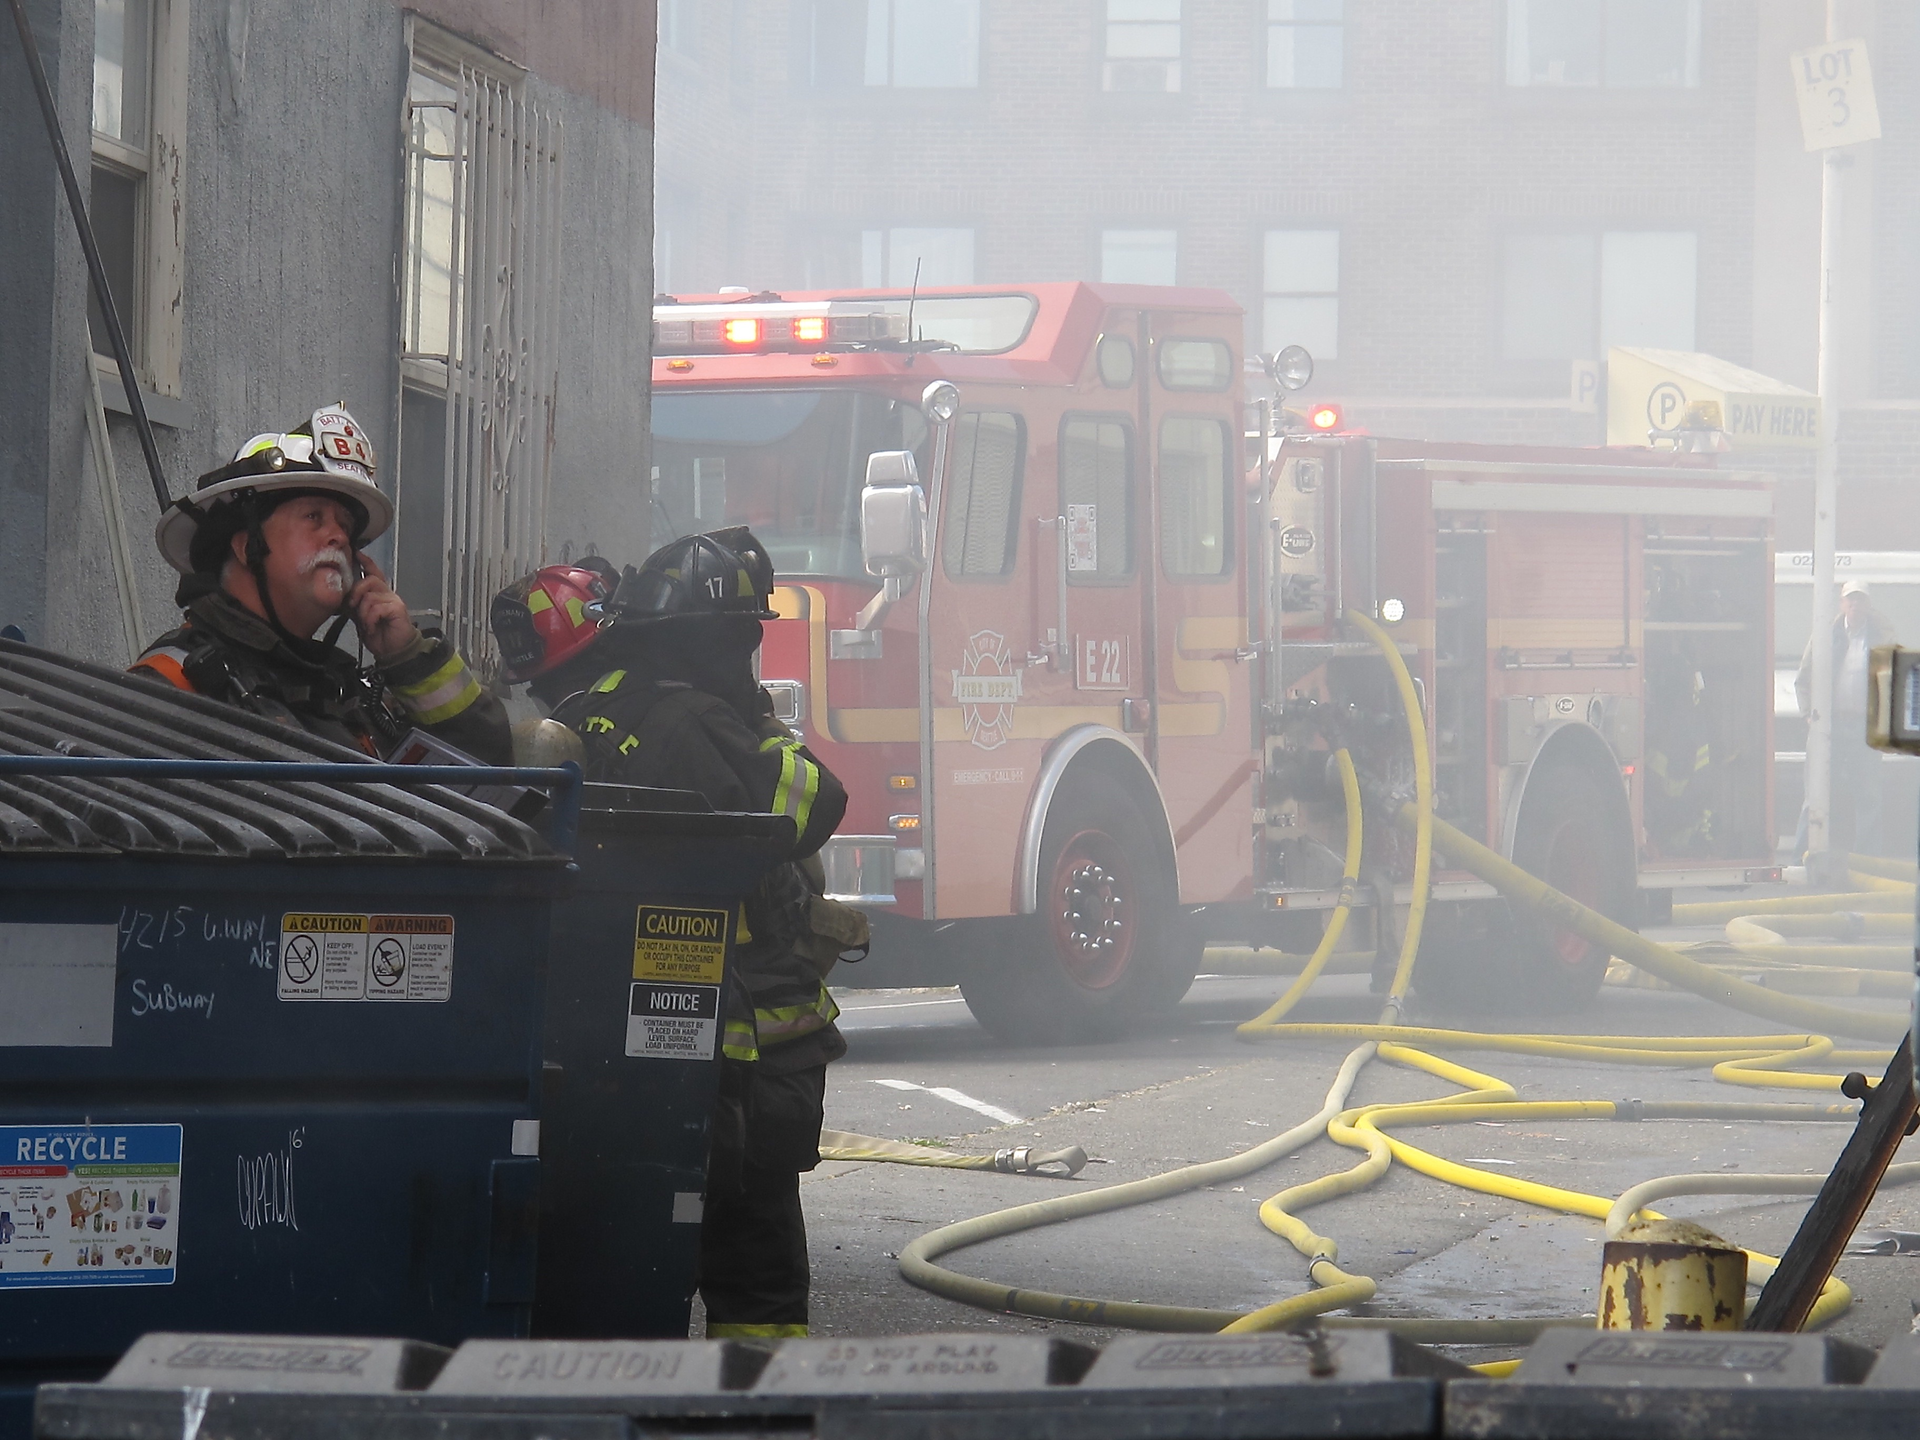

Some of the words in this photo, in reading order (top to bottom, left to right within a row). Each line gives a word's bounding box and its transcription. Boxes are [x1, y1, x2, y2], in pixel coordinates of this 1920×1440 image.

[1802, 48, 1854, 85] LOT
[1827, 86, 1851, 128] 3
[1660, 393, 1676, 425] P
[1732, 404, 1765, 434] PAY
[1769, 406, 1816, 438] HERE
[334, 437, 352, 456] B
[705, 576, 723, 599] 17
[1086, 640, 1097, 682] E
[1101, 640, 1121, 683] 22
[961, 682, 984, 698] FIRE
[119, 906, 194, 951] 4215
[301, 917, 362, 931] CAUTION
[384, 918, 447, 932] WARNING
[646, 914, 718, 937] CAUTION
[650, 992, 700, 1011] NOTICE
[643, 1019, 677, 1028] CONTAINER
[678, 1020, 695, 1029] MUST
[696, 1021, 704, 1029] BE
[648, 1027, 671, 1035] PLACED
[672, 1028, 681, 1036] ON
[682, 1028, 699, 1036] HARD
[645, 1042, 661, 1050] LOAD
[17, 1137, 127, 1161] RECYCLE
[827, 1346, 858, 1361] DO
[494, 1351, 684, 1381] CAUTION
